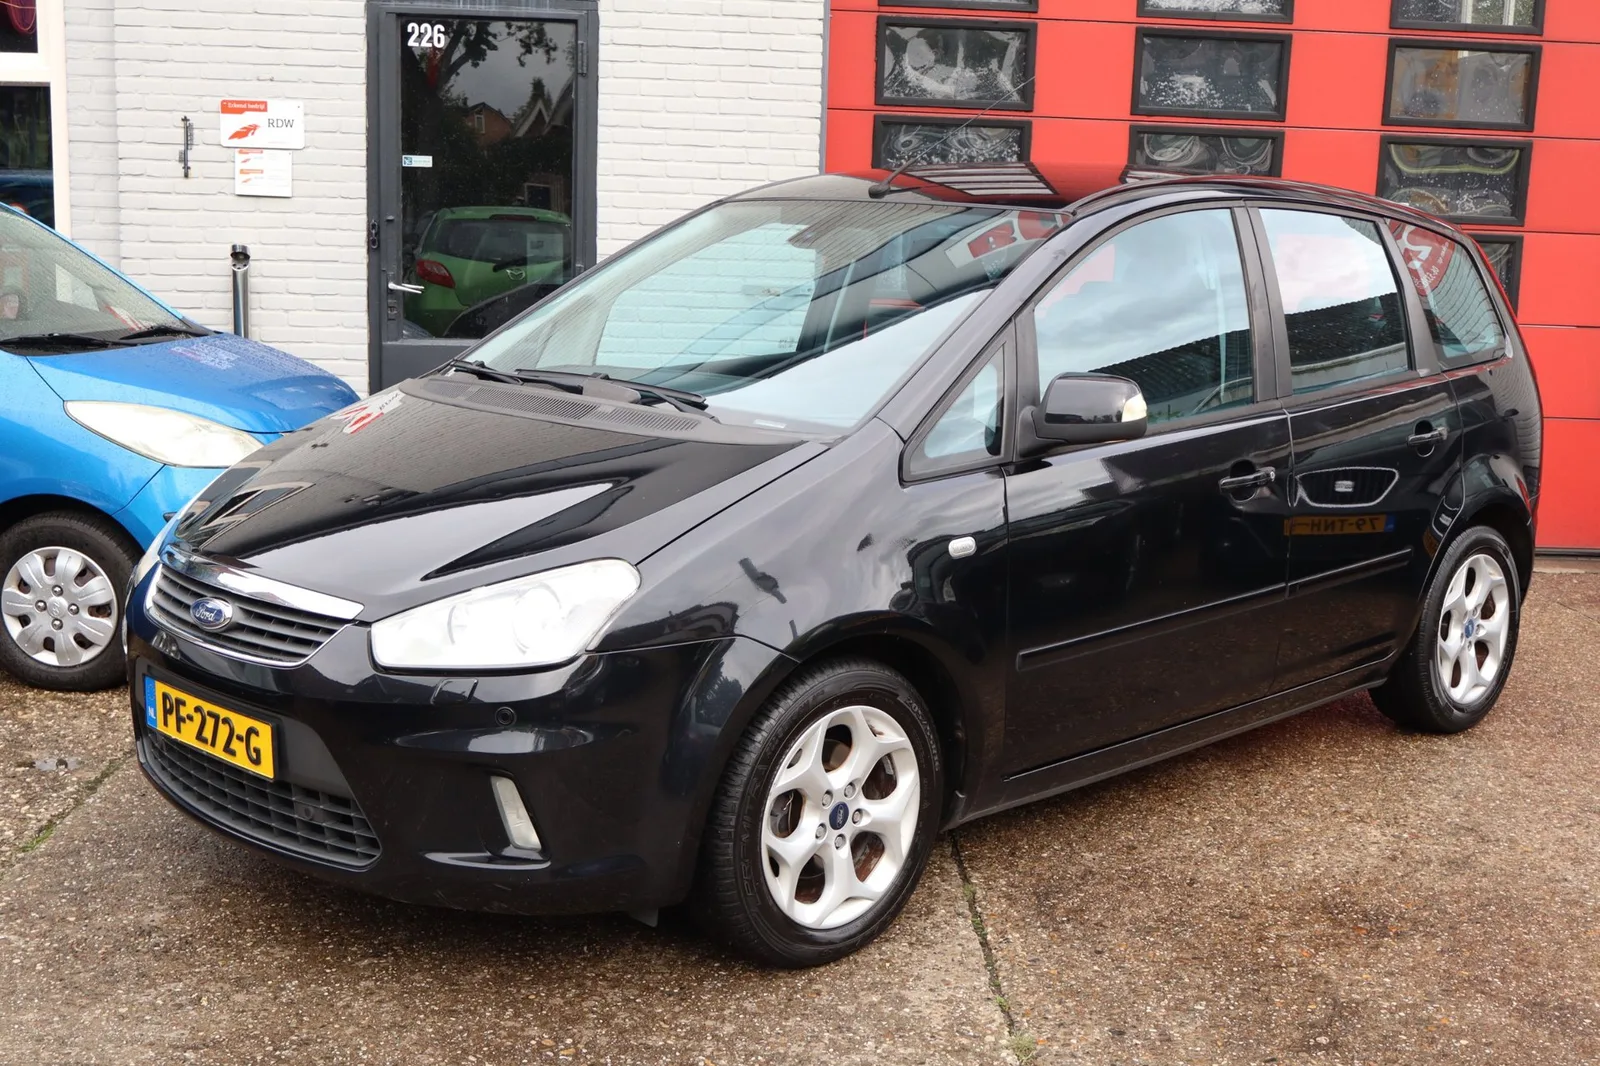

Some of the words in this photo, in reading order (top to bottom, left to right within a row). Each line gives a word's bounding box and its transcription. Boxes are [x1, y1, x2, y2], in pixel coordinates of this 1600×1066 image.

[407, 22, 445, 48] 226
[267, 118, 295, 128] RDW
[194, 603, 216, 622] Ford
[161, 691, 262, 766] PF-272-G
